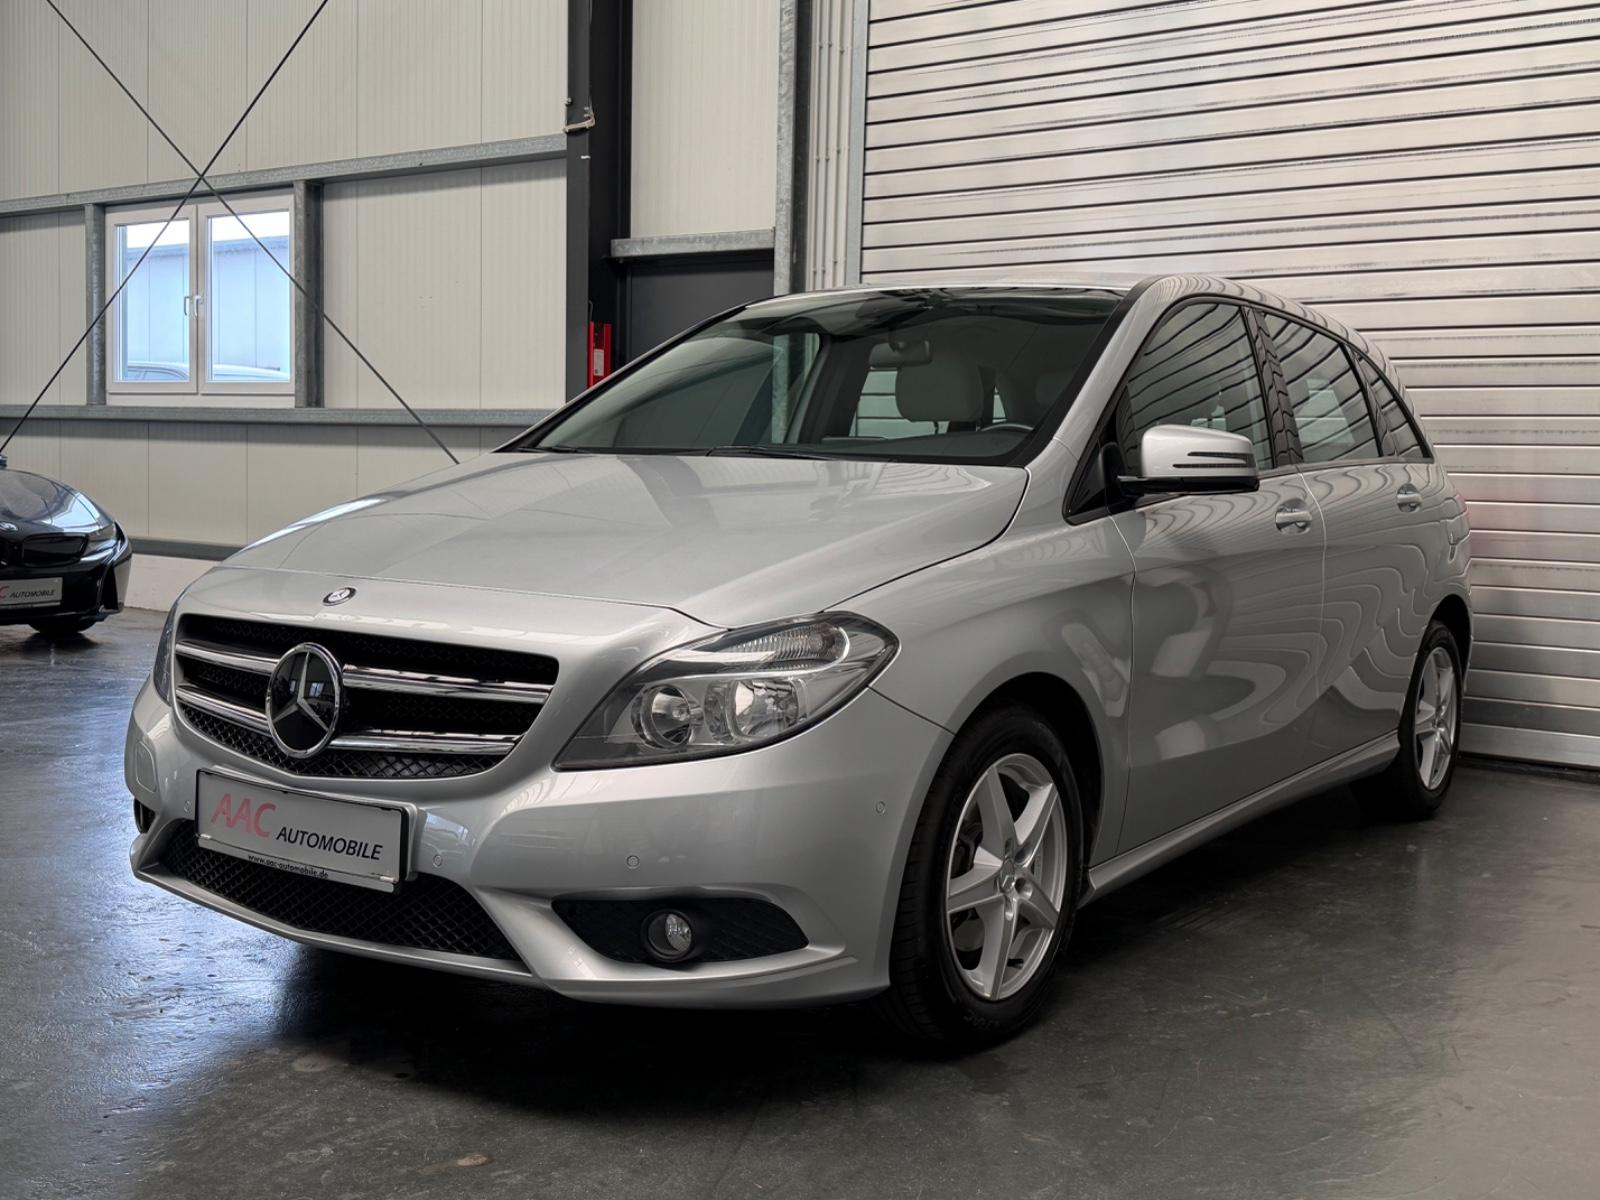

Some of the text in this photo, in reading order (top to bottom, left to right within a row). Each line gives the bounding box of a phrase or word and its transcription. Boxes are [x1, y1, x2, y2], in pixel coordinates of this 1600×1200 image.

[10, 590, 55, 598] AUTOMOBILE
[210, 793, 383, 861] AAC AUTOMOBILE
[248, 854, 329, 879] www.aac-automobile.de
